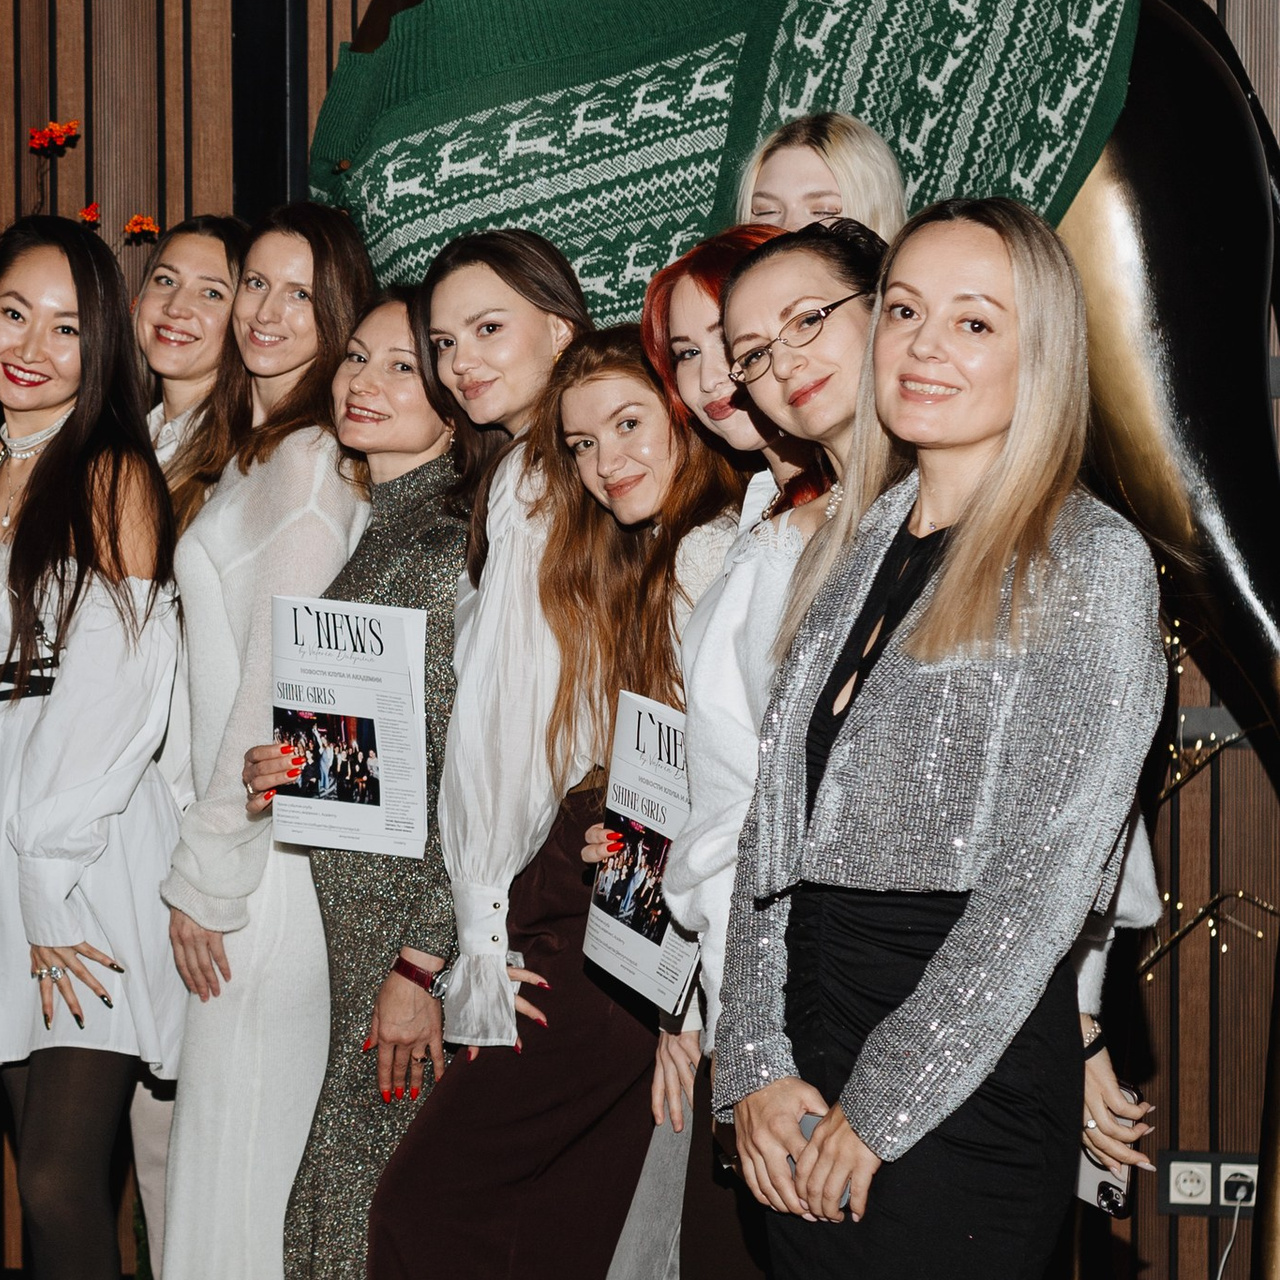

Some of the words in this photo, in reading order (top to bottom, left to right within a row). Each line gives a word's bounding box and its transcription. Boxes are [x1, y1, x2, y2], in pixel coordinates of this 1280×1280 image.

[300, 667, 328, 677] НОВОСТИ
[276, 681, 305, 703] SHINE
[306, 685, 336, 706] GIRLS
[611, 782, 640, 813] SHINE
[640, 796, 668, 825] GIRLS
